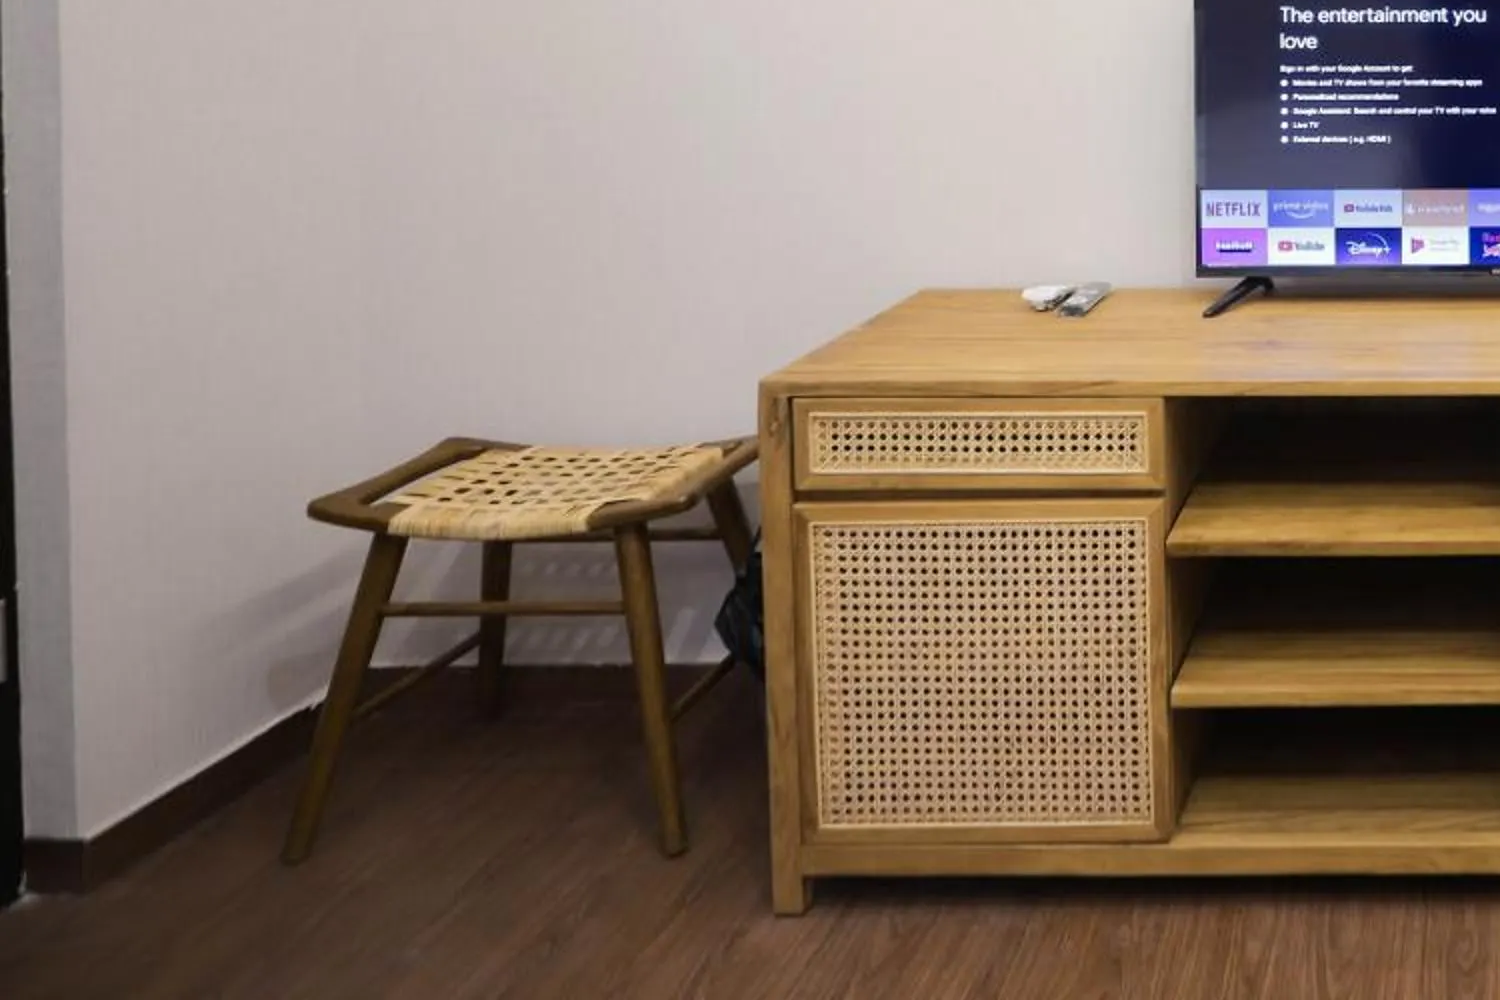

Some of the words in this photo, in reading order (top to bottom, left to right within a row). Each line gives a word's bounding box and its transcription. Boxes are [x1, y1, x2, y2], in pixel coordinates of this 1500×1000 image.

[1280, 6, 1314, 23] The
[1317, 5, 1448, 23] entertainment
[1452, 8, 1488, 27] you
[1279, 32, 1318, 49] love
[1206, 202, 1262, 217] NETFLIX
